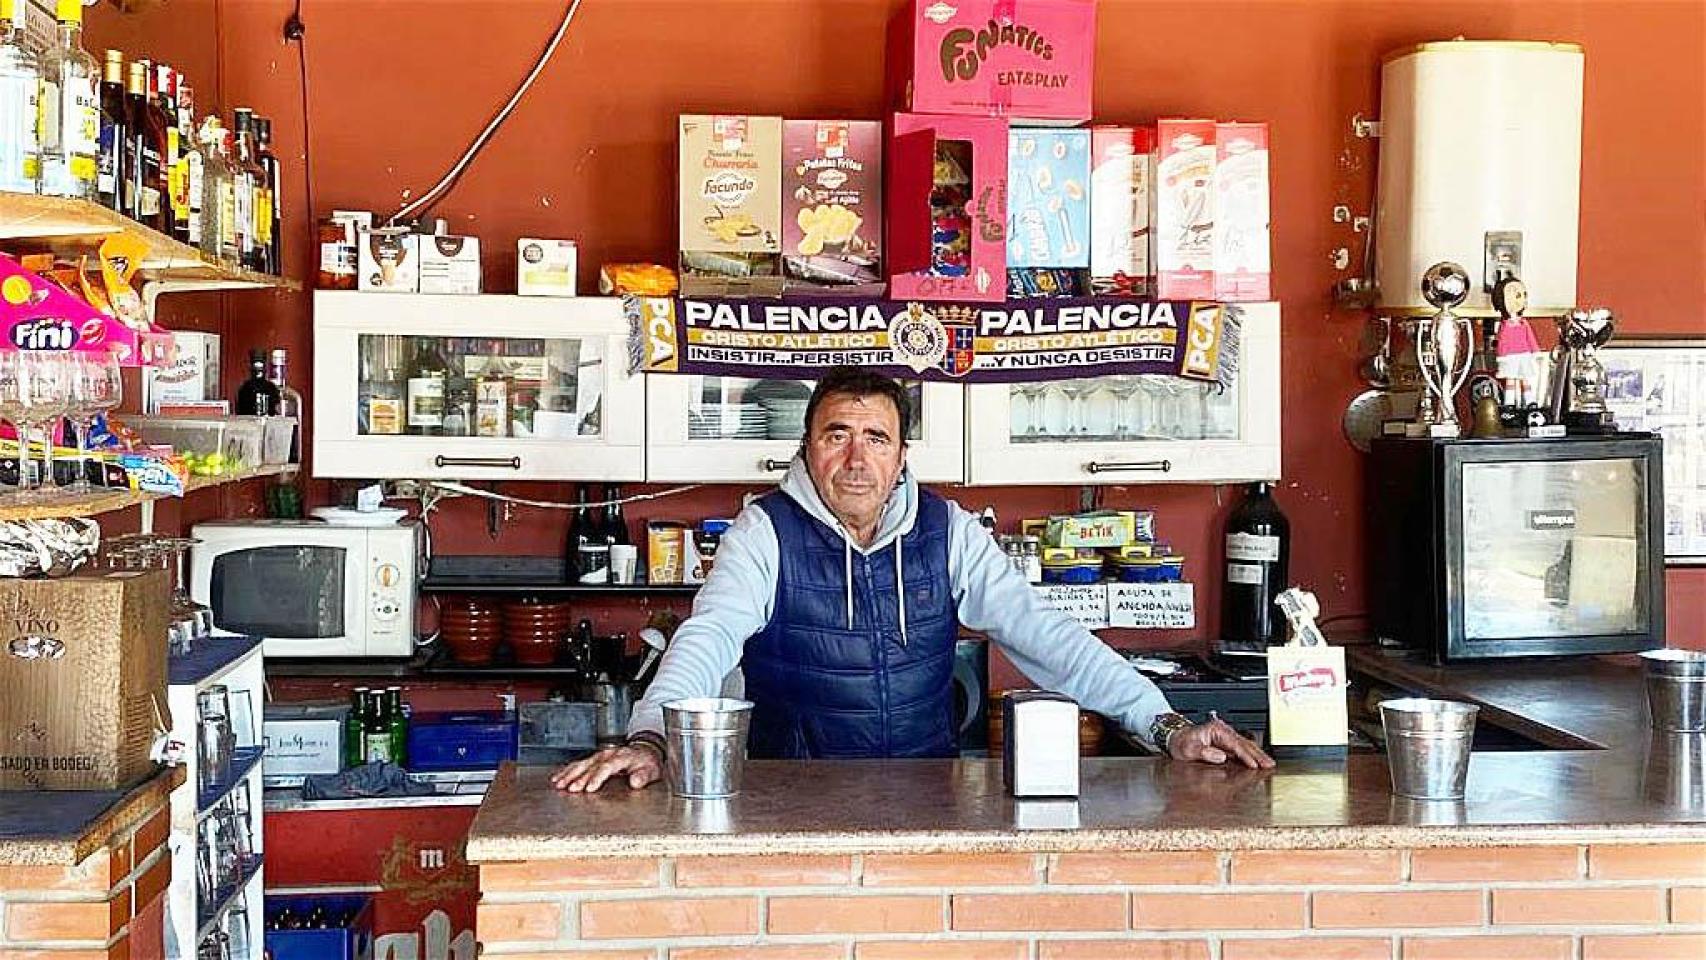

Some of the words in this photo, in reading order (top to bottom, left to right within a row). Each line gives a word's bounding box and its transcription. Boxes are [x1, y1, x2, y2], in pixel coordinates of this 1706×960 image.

[997, 70, 1069, 88] EAT&PLAY
[704, 178, 754, 195] Facundo
[685, 301, 888, 331] PALENCIA
[980, 302, 1177, 336] PALENCIA
[15, 321, 73, 349] Fini
[1011, 353, 1081, 366] NUNCA
[1086, 348, 1172, 362] DESISTIR
[15, 619, 59, 634] VINO
